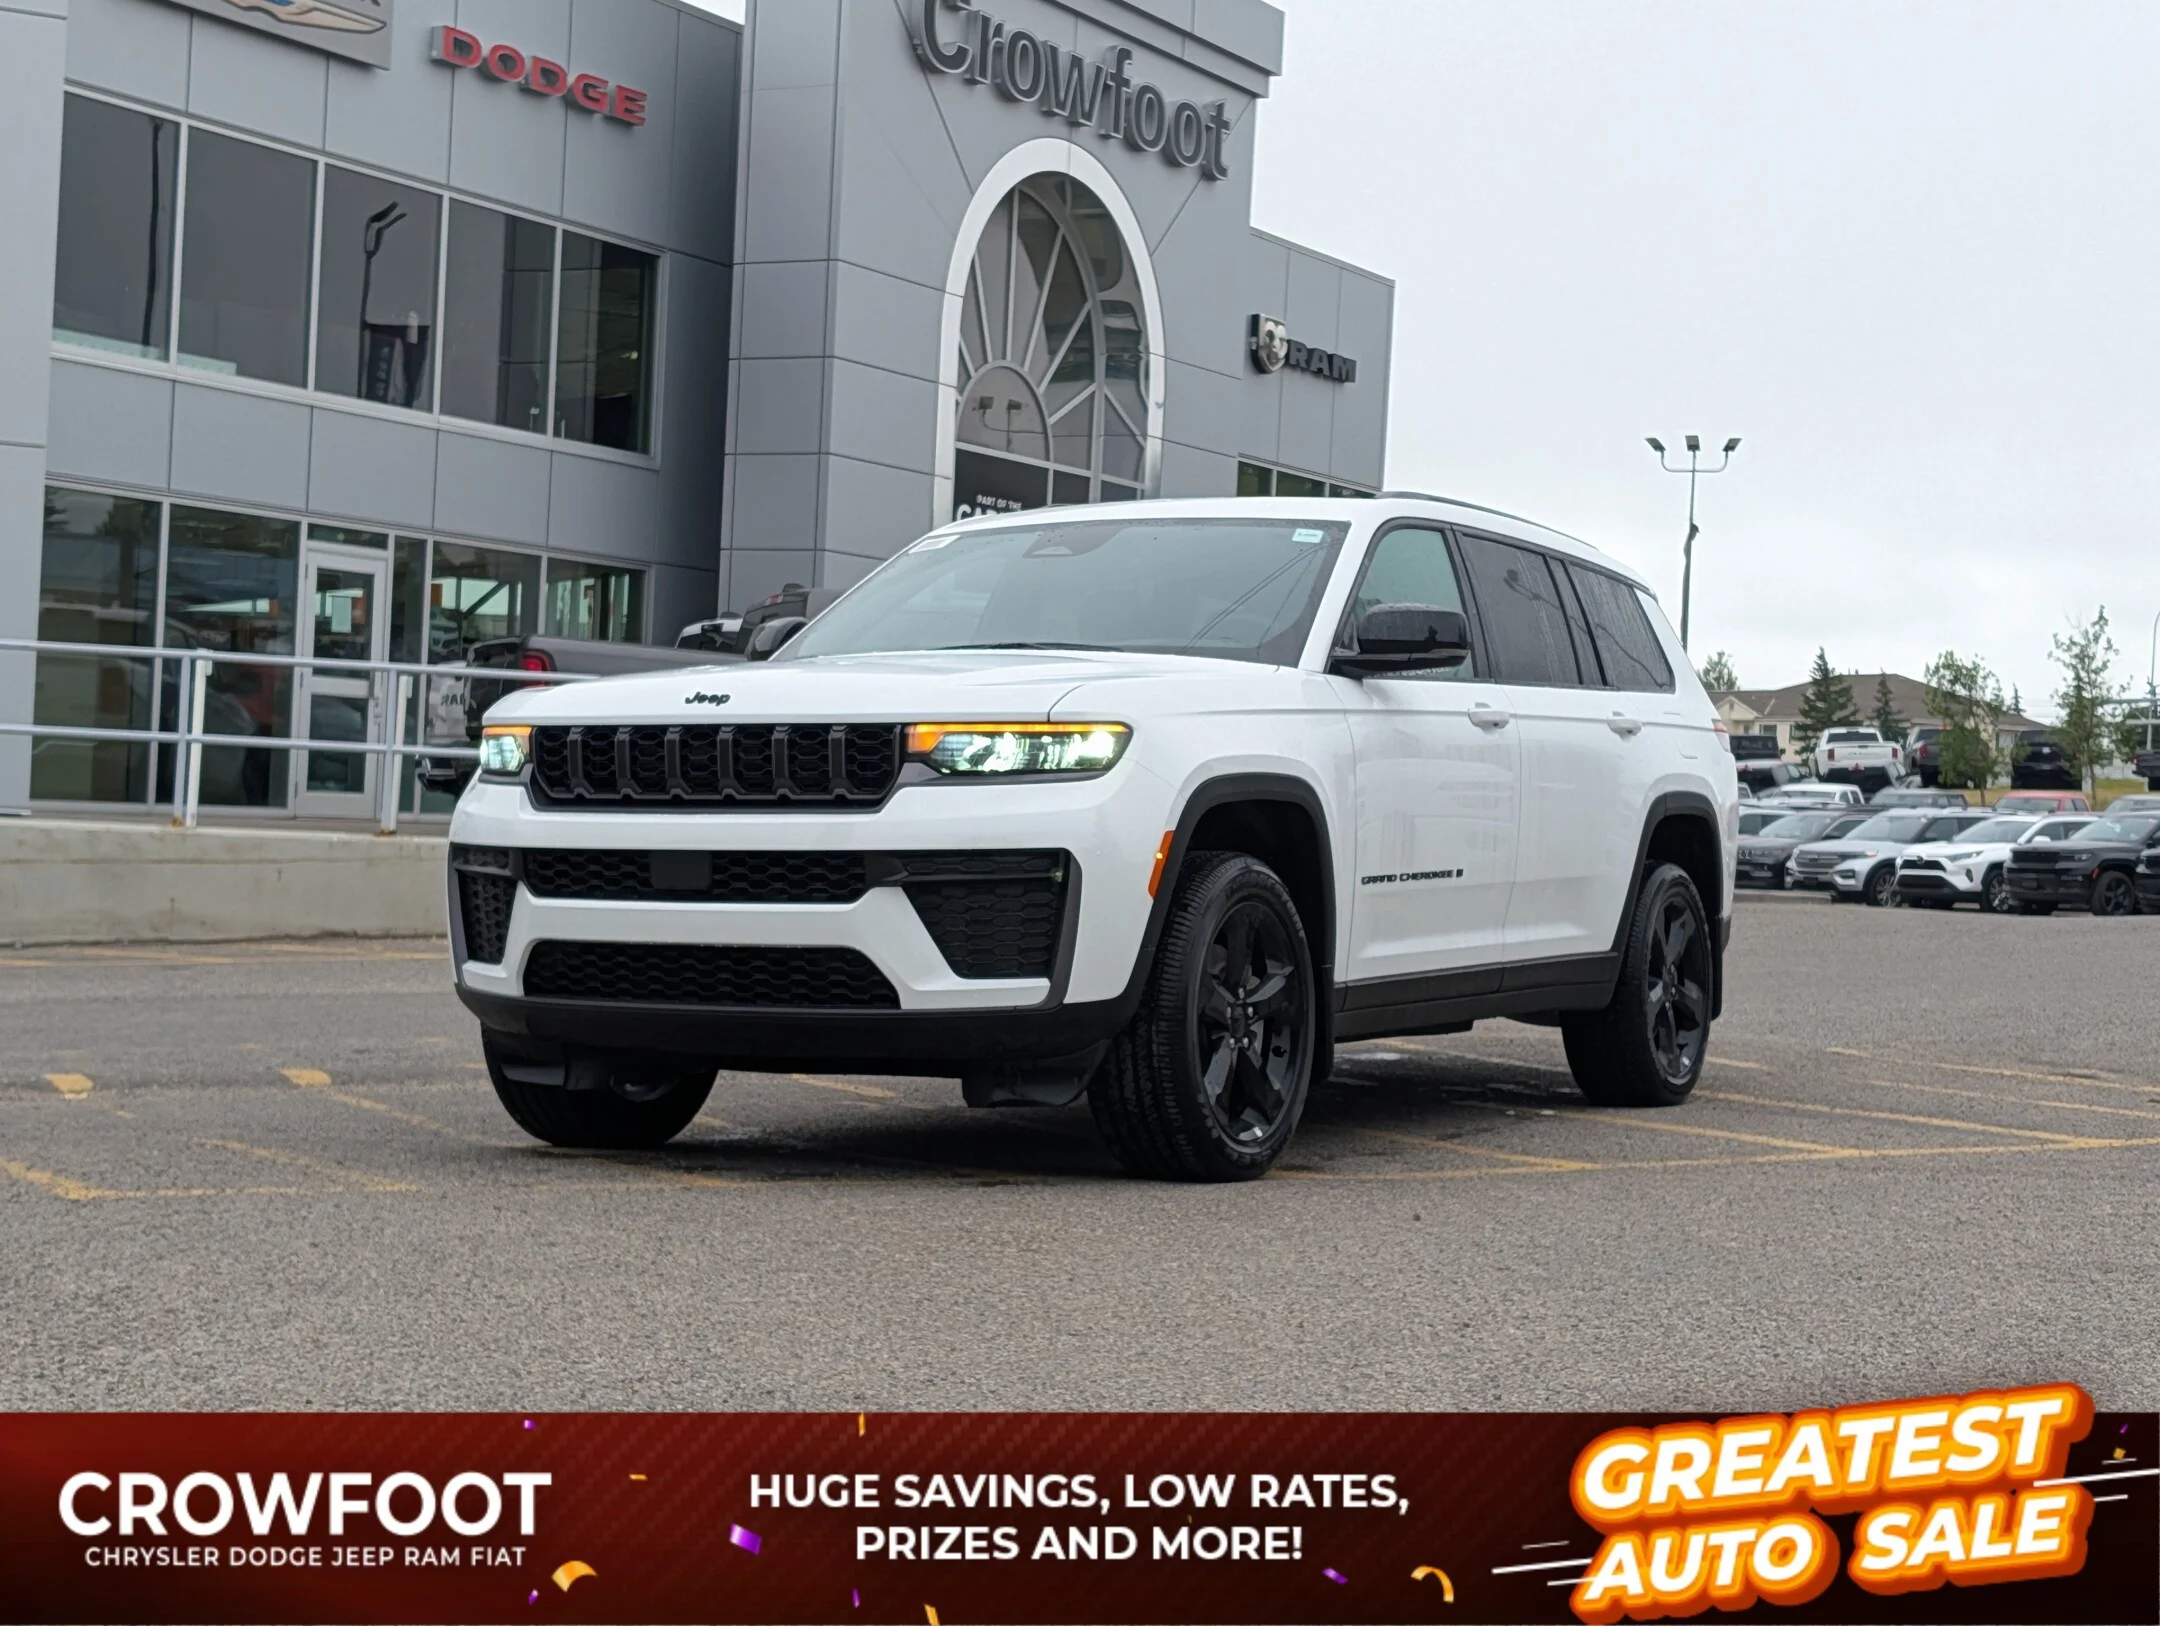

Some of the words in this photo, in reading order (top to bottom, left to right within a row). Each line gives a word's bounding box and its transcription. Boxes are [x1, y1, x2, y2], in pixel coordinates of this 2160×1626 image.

[432, 25, 648, 126] DODGE
[912, 0, 1230, 181] Crowfoot
[1286, 338, 1357, 383] RAM
[685, 691, 731, 707] Jeep
[1361, 874, 1398, 885] GRAND
[1399, 869, 1454, 882] CHEROKEE
